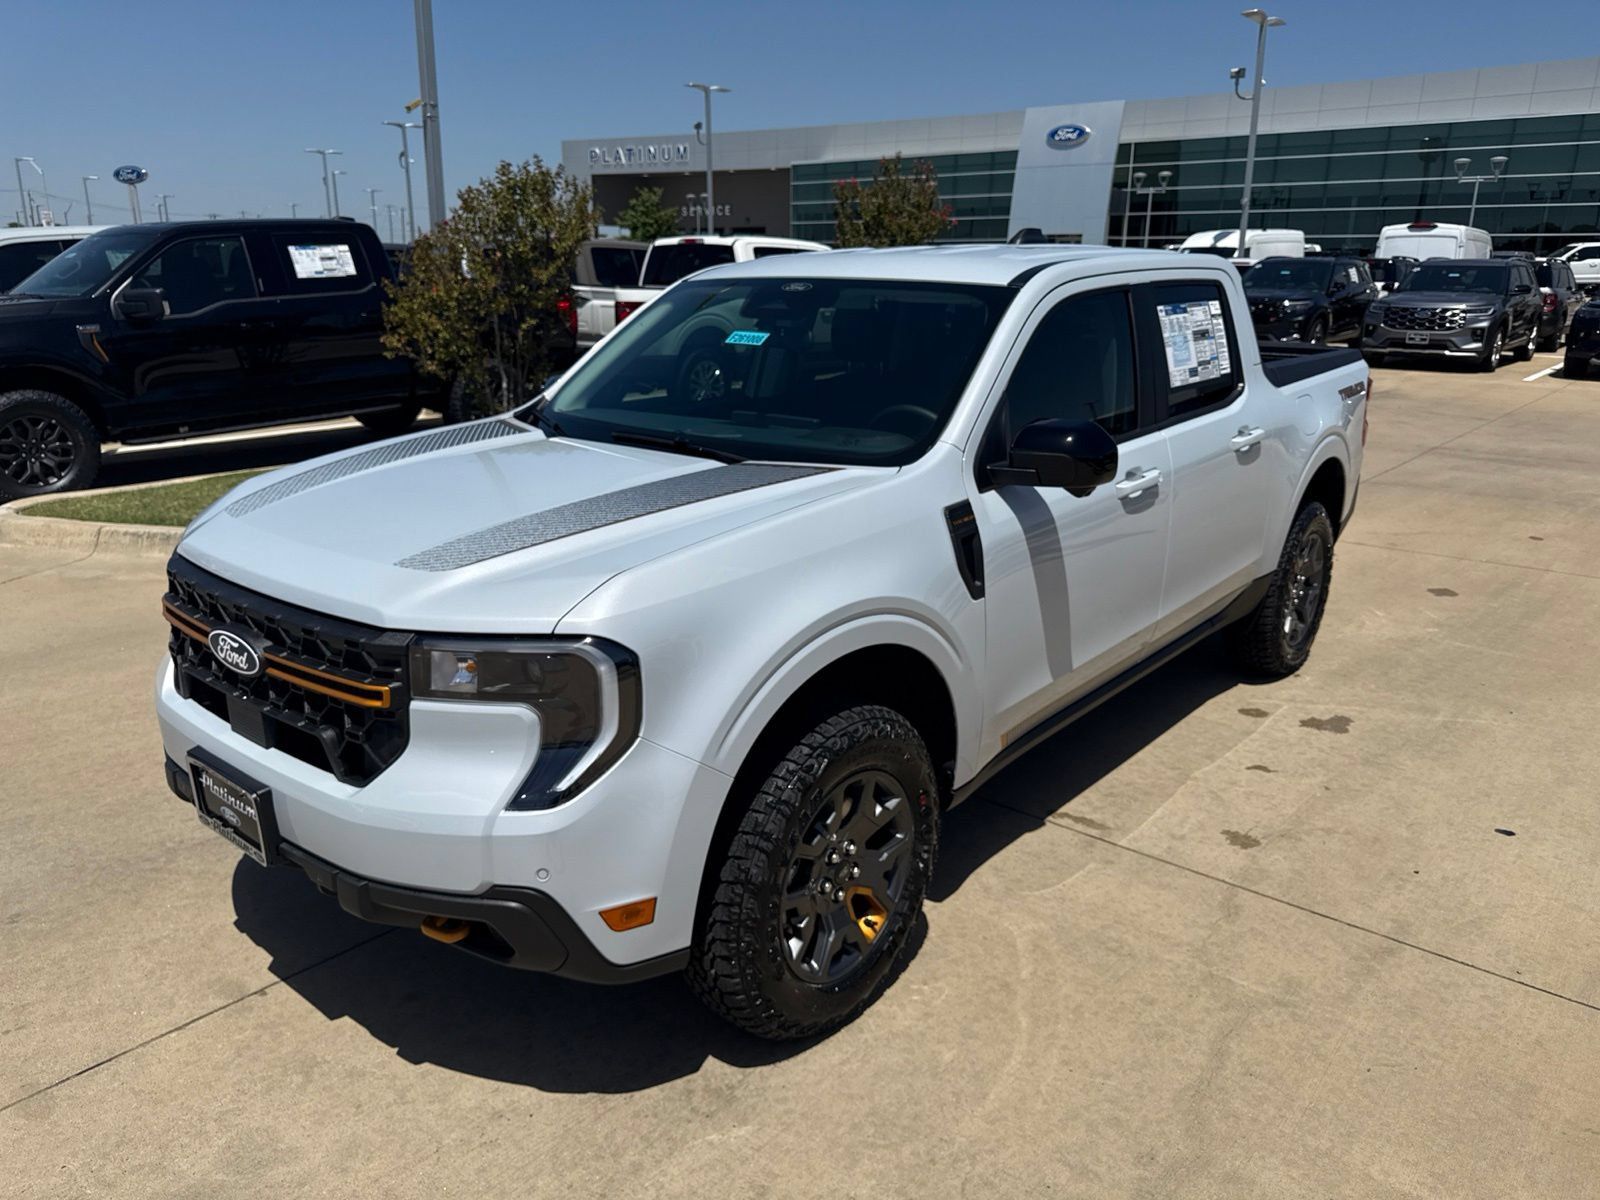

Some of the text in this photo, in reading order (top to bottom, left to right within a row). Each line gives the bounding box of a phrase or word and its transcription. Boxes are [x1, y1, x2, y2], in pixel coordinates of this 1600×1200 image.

[1054, 127, 1080, 141] Ford
[588, 143, 690, 165] PLATINUM
[217, 634, 249, 670] Ford
[199, 770, 258, 820] Platinum
